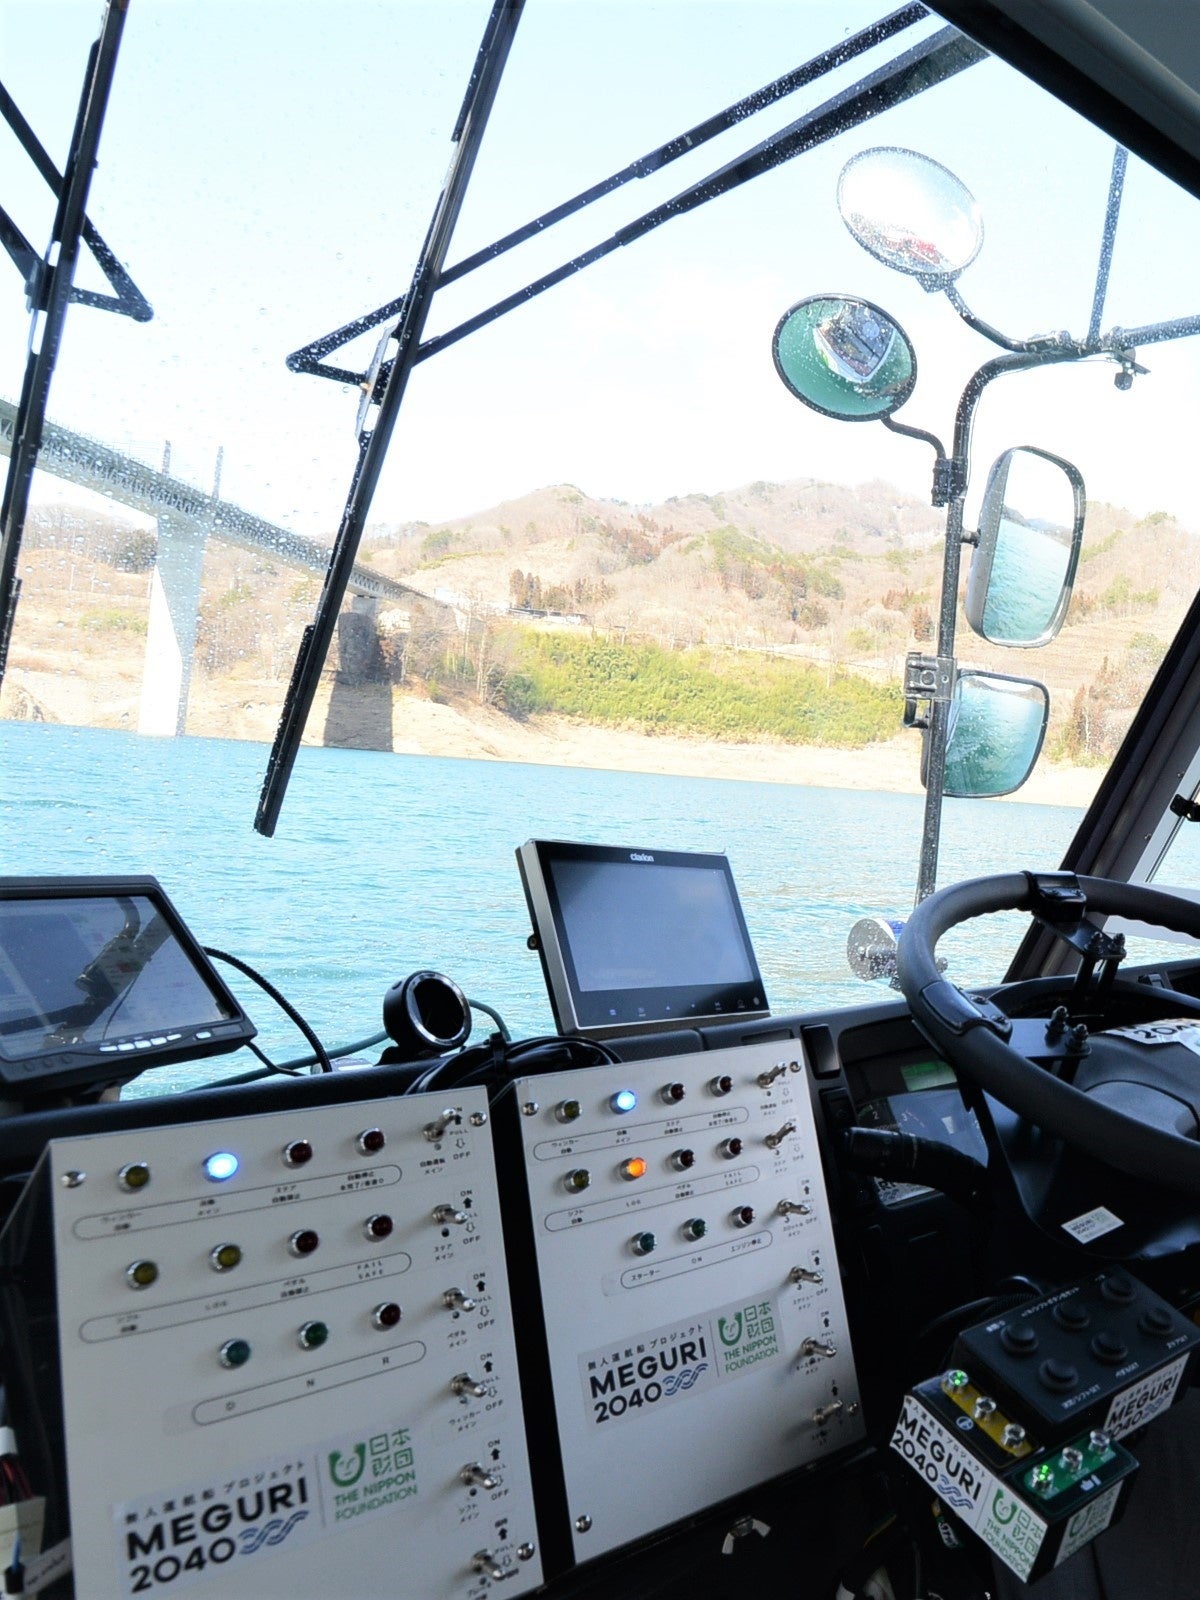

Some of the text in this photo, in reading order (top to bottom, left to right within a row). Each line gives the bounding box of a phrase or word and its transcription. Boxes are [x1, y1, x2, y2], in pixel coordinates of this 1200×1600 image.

[630, 853, 655, 862] clarion
[453, 1151, 471, 1160] OFF
[460, 1189, 473, 1197] ON
[463, 1235, 481, 1245] OFF
[473, 1272, 486, 1280] ON
[477, 1318, 495, 1330] OFF
[744, 1301, 772, 1323] 日本
[650, 1323, 703, 1349] プロジェクト
[747, 1317, 774, 1339] 財団
[480, 1352, 493, 1361] ON
[723, 1333, 777, 1362] THE NIPPON
[725, 1345, 779, 1373] FOUNDATION
[382, 1356, 391, 1365] R
[589, 1337, 707, 1399] MEGURI
[306, 1378, 316, 1387] N
[485, 1399, 504, 1412] OFF
[594, 1382, 662, 1424] 2040
[1108, 1373, 1179, 1427] MEGURI
[369, 1428, 411, 1455] 日本
[488, 1439, 501, 1448] ON
[372, 1447, 414, 1477] 財団
[892, 1430, 938, 1482] 2040
[899, 1408, 981, 1501] MEGURI
[223, 1461, 305, 1494] プロジェクト
[335, 1469, 416, 1506] THE NIPPON
[335, 1485, 417, 1521] FOUNDATION
[491, 1488, 510, 1501] OFF
[126, 1477, 309, 1560] MEGURI
[986, 1518, 1002, 1537] THE
[130, 1537, 236, 1593] 2040
